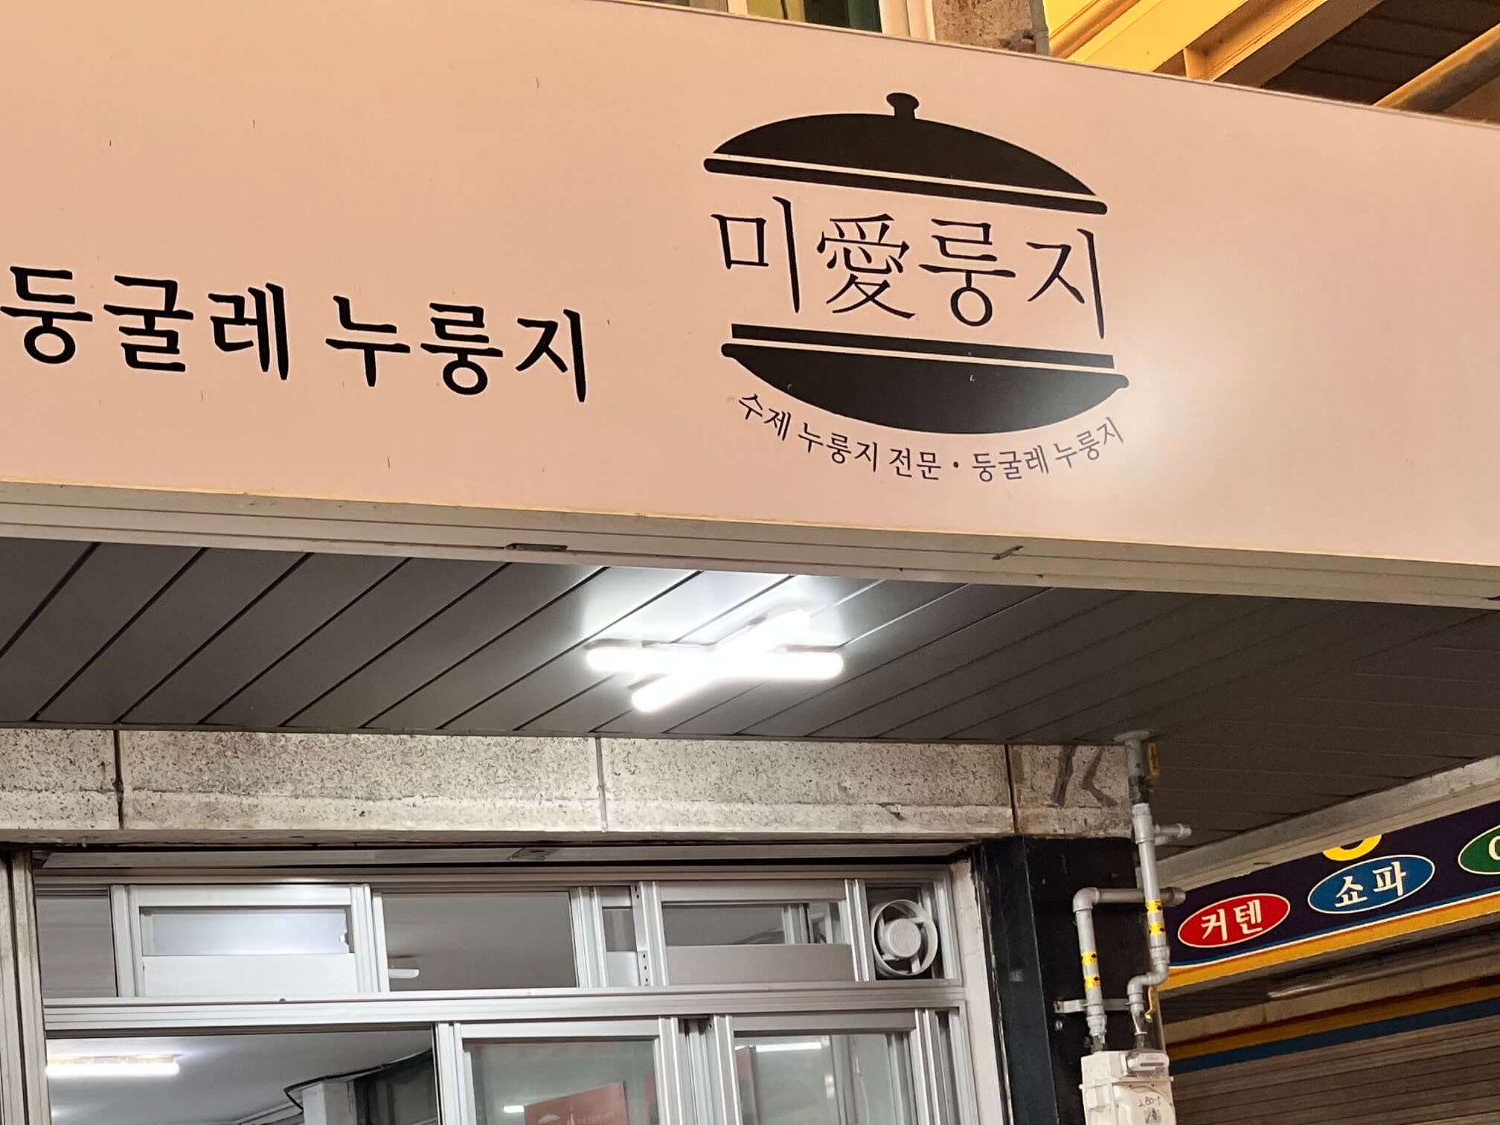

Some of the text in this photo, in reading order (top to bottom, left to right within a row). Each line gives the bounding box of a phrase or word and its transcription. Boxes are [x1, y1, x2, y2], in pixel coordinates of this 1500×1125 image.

[709, 195, 1106, 340] 미愛룽지
[0, 262, 291, 381] 둥굴레
[325, 295, 589, 403] 누룽지
[737, 393, 1125, 482] 수제 누룽지 전문 둥굴레 누룽지
[1201, 898, 1263, 943] 커텐
[1334, 861, 1407, 908] 쇼파
